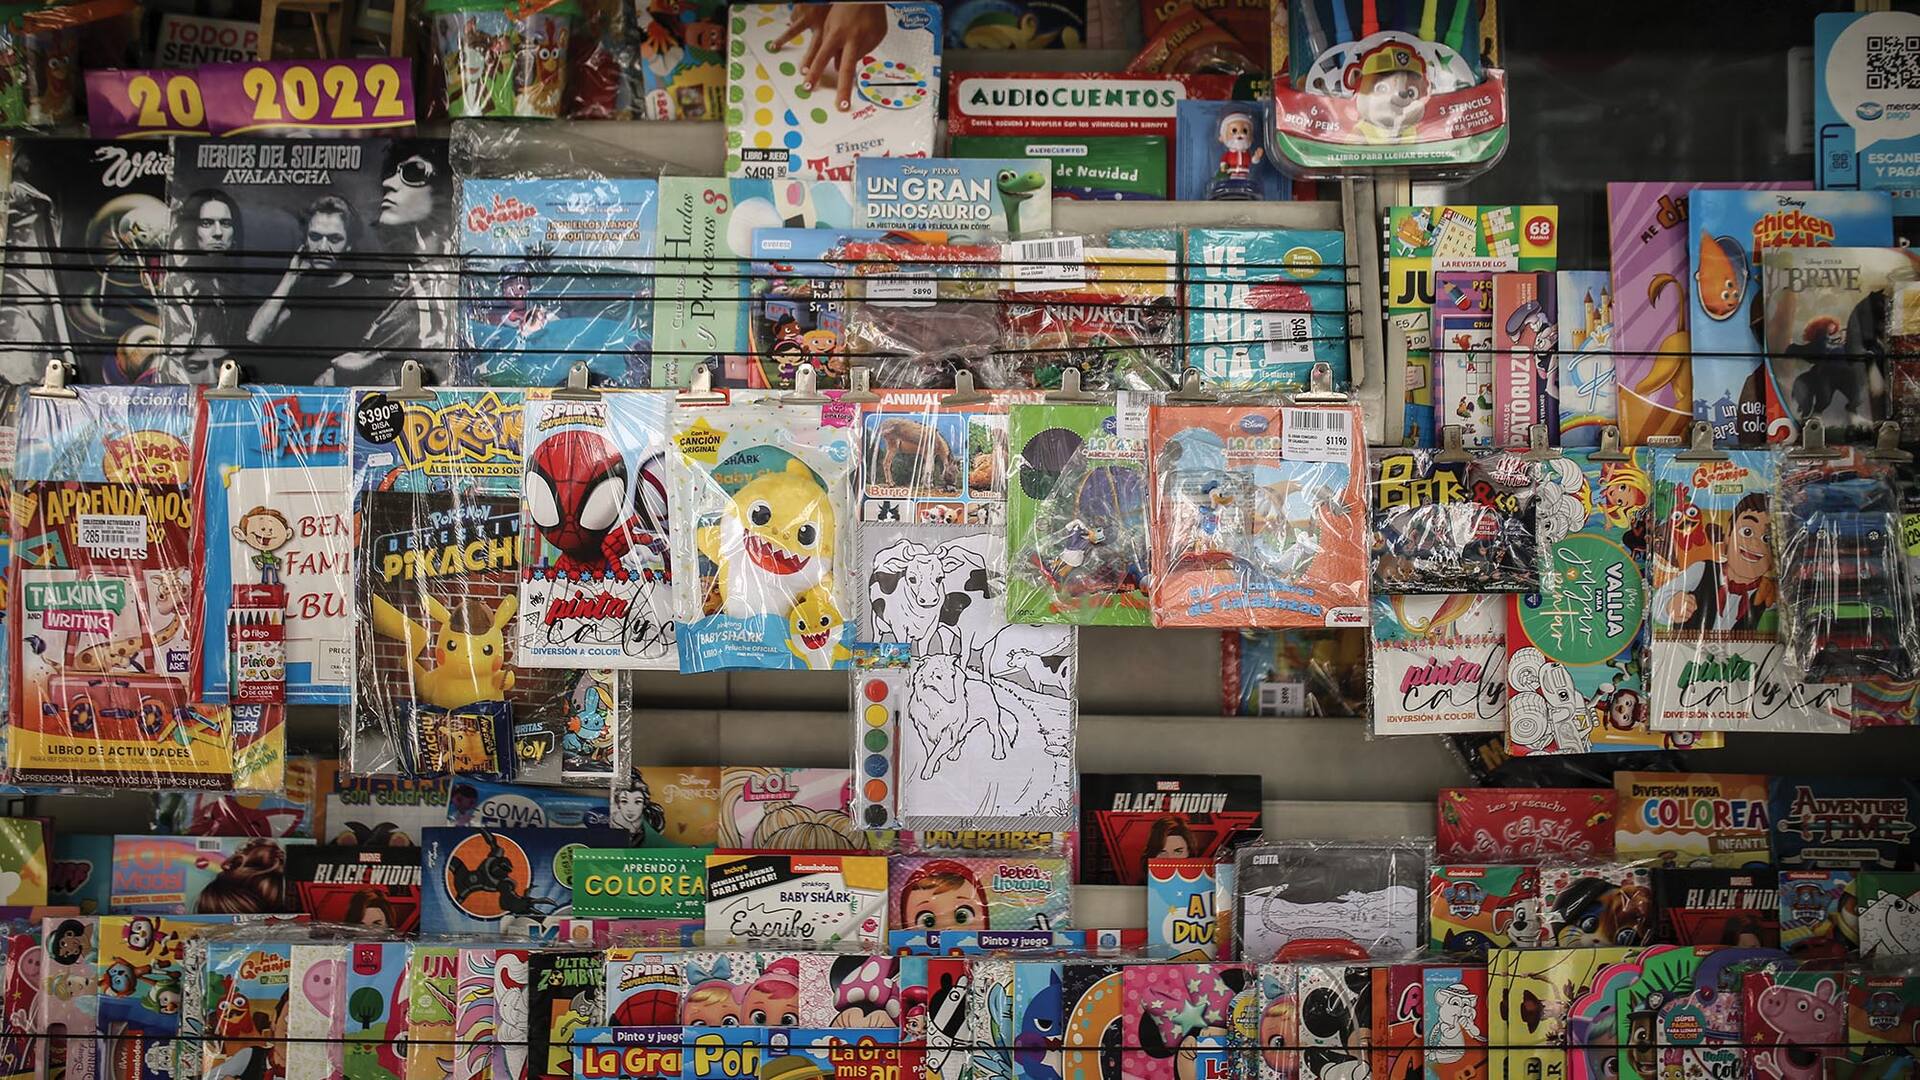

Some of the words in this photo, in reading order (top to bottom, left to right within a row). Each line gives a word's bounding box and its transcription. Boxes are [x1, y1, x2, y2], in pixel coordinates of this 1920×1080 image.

[168, 22, 238, 47] TODO
[243, 63, 403, 121] 2022
[971, 87, 1176, 108] AUDIOCUENTOS
[1310, 105, 1318, 116] 6
[1439, 106, 1446, 116] 3
[1449, 95, 1492, 113] STENCILS
[1467, 114, 1495, 128] PINTAR
[1886, 111, 1911, 121] pago
[1314, 121, 1340, 132] PENS
[835, 138, 885, 154] Finger
[197, 145, 257, 170] HEROES
[259, 145, 288, 170] DEL
[292, 145, 362, 170] SILENCIO
[744, 152, 763, 161] LIBRO
[768, 152, 788, 161] JUEGO
[222, 169, 332, 185] AVALANCHA
[744, 166, 774, 179] $499
[900, 165, 928, 176] Disney
[1055, 163, 1071, 177] de
[1077, 165, 1138, 182] Navidad
[1875, 167, 1885, 177] Y
[866, 177, 897, 193] UN
[901, 178, 991, 202] GRAN
[1777, 195, 1807, 210] Disney
[866, 203, 992, 220] DINOSAURIO
[664, 193, 694, 264] Hadas
[1529, 221, 1551, 235] 68
[1753, 209, 1836, 238] chicken
[1641, 226, 1660, 245] ME
[690, 216, 716, 320] Princesas
[703, 188, 728, 215] 3
[1441, 261, 1451, 269] LA
[1452, 261, 1480, 269] REVISTA
[1481, 261, 1491, 269] DE
[1493, 261, 1507, 269] LOS
[1784, 267, 1863, 293] BRAVE
[95, 390, 174, 407] Colección
[357, 404, 391, 427] $390
[541, 403, 608, 420] SPIDEY
[1722, 403, 1737, 418] un
[371, 421, 390, 431] DISA
[1244, 419, 1269, 431] Disney
[680, 435, 721, 447] CANCIÓN
[1325, 435, 1348, 447] $1190
[682, 445, 717, 454] ORIGINAL
[724, 453, 761, 466] SHARK
[429, 464, 461, 475] ÁLBUM
[463, 465, 486, 475] CON
[487, 466, 500, 475] 20
[869, 485, 910, 499] Burro
[28, 581, 118, 608] TALKING
[1594, 587, 1604, 613] PARA
[1604, 561, 1625, 640] VALIJA
[544, 588, 629, 626] pinta
[1187, 602, 1213, 617] de
[27, 612, 42, 620] AND
[46, 611, 112, 632] WRITING
[251, 627, 270, 640] filgo
[700, 632, 734, 645] BABY
[732, 629, 764, 644] SHARK
[530, 646, 579, 657] ¡DIVERSIÓN
[580, 648, 587, 656] A
[588, 647, 621, 657] COLOR!
[724, 642, 751, 653] Peluche
[751, 645, 778, 654] OFICIAL
[169, 662, 186, 671] ARE
[240, 654, 276, 669] Pinto
[1400, 656, 1482, 694] pinta
[1677, 652, 1758, 689] pinta
[248, 684, 280, 693] CRAYONES
[248, 689, 257, 697] DE
[257, 690, 273, 698] CERA
[1386, 713, 1433, 724] ¡DIVERSIÓN
[1443, 712, 1476, 722] COLOR!
[1663, 709, 1709, 719] ¡DIVERSIÓN
[48, 744, 83, 756] LIBRO
[89, 745, 104, 756] DE
[108, 746, 192, 759] ACTIVIDADES
[140, 776, 188, 788] DIVERTIMOS
[189, 778, 198, 787] EN
[200, 778, 222, 788] CASA
[1156, 780, 1181, 791] MARVEL
[1631, 783, 1689, 798] DIVERSIÓN
[1691, 785, 1720, 798] PARA
[1112, 792, 1168, 813] BLACK
[1169, 793, 1229, 814] WIDOW
[1487, 802, 1507, 814] Leo
[1508, 800, 1518, 812] y
[1520, 799, 1568, 814] escucho
[1790, 785, 1909, 816] ADVENTURE
[481, 801, 544, 826] GOMA
[957, 817, 974, 829] 10
[1818, 813, 1911, 845] TIME
[1716, 837, 1769, 851] INFANTIL
[359, 852, 381, 862] MARVEL
[1252, 855, 1279, 866] CHITA
[313, 865, 363, 884] BLACK
[622, 862, 677, 874] APRENDO
[679, 863, 688, 873] A
[723, 863, 749, 876] Incluye
[793, 864, 839, 873] nickelodeon
[999, 864, 1039, 879] Bebés
[709, 873, 745, 890] ¡GENIALES
[744, 865, 775, 880] PÁGINAS
[801, 879, 830, 891] pinkfong
[1729, 875, 1754, 888] MARVEL
[711, 884, 738, 899] PARA
[739, 872, 779, 891] PINTAR!
[780, 891, 809, 903] BABY
[809, 888, 851, 904] SHARK
[1684, 887, 1739, 911] BLACK
[675, 902, 683, 910] y
[729, 909, 815, 939] Escribe
[981, 935, 1012, 946] Pinto
[1012, 937, 1019, 948] y
[1018, 936, 1049, 949] juego
[259, 951, 280, 963] La
[617, 1031, 646, 1043] Pinto
[647, 1034, 655, 1045] y
[830, 1038, 862, 1062] La
[584, 1045, 619, 1075] La
[837, 1063, 868, 1077] mis
